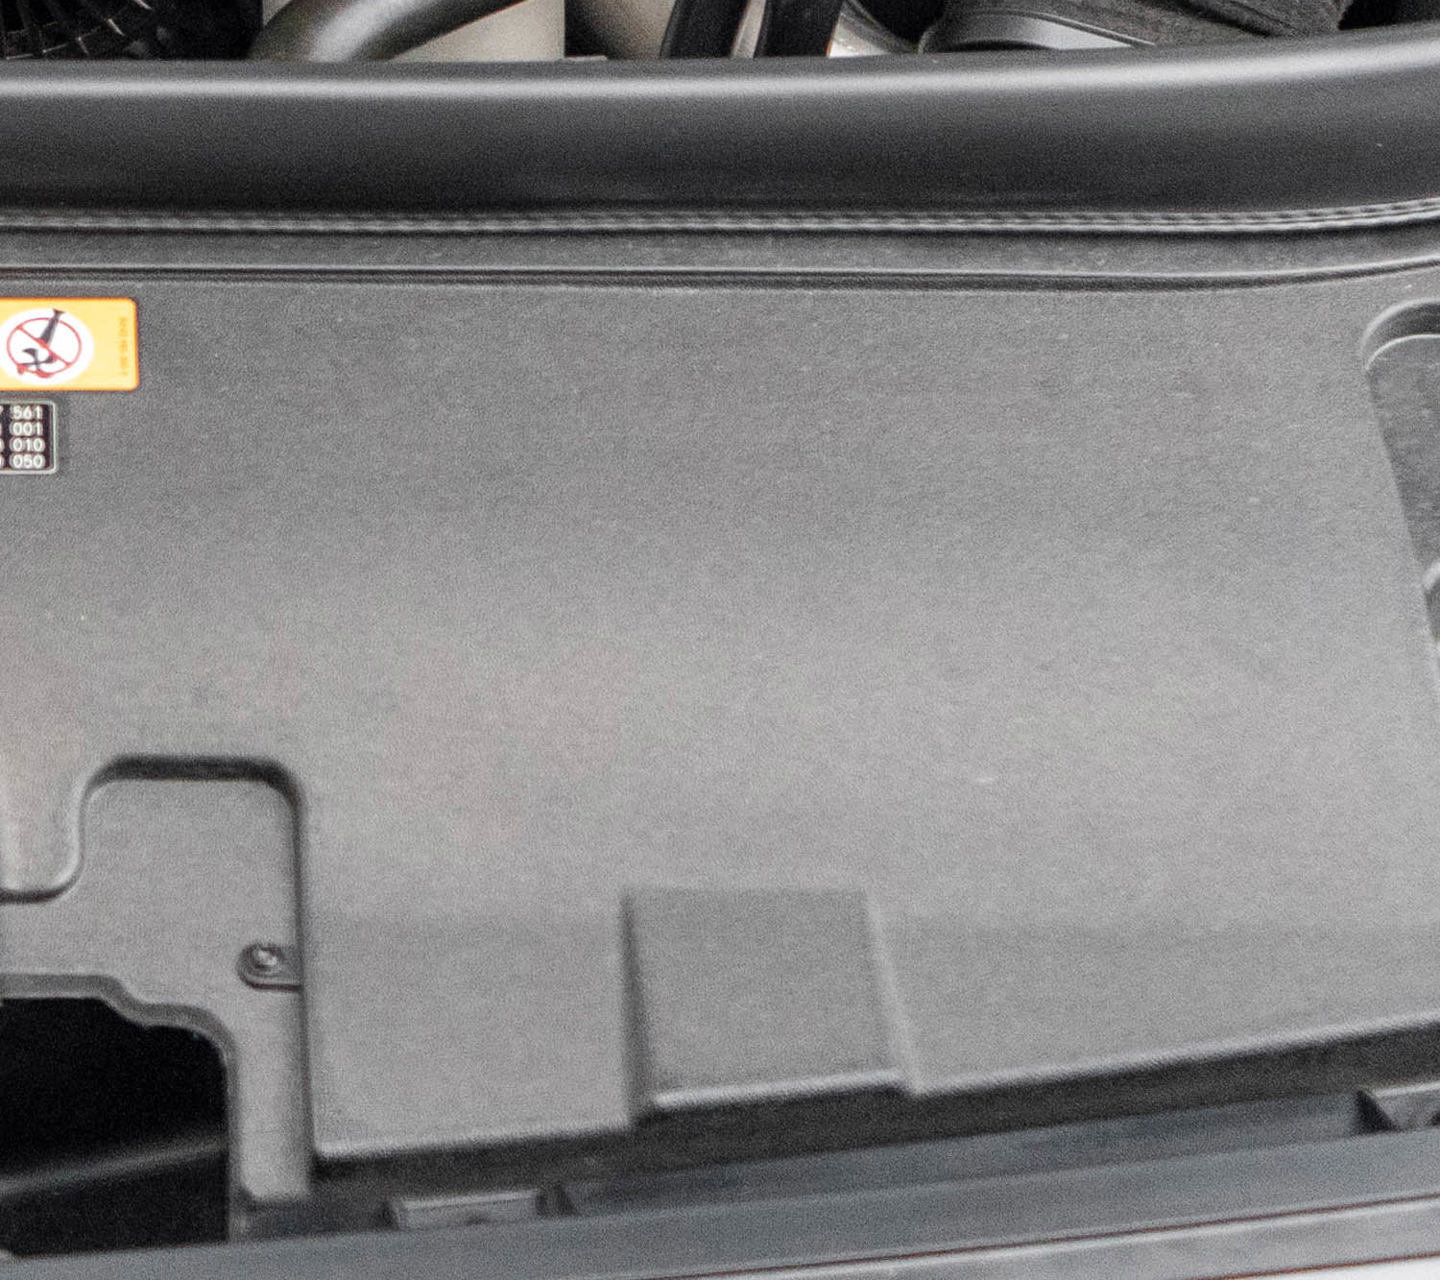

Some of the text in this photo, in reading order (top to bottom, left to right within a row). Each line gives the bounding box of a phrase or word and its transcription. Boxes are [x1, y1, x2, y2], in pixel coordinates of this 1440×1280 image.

[12, 405, 41, 419] 561
[12, 421, 42, 436] 001
[12, 437, 43, 452] 010
[12, 454, 43, 468] 050
